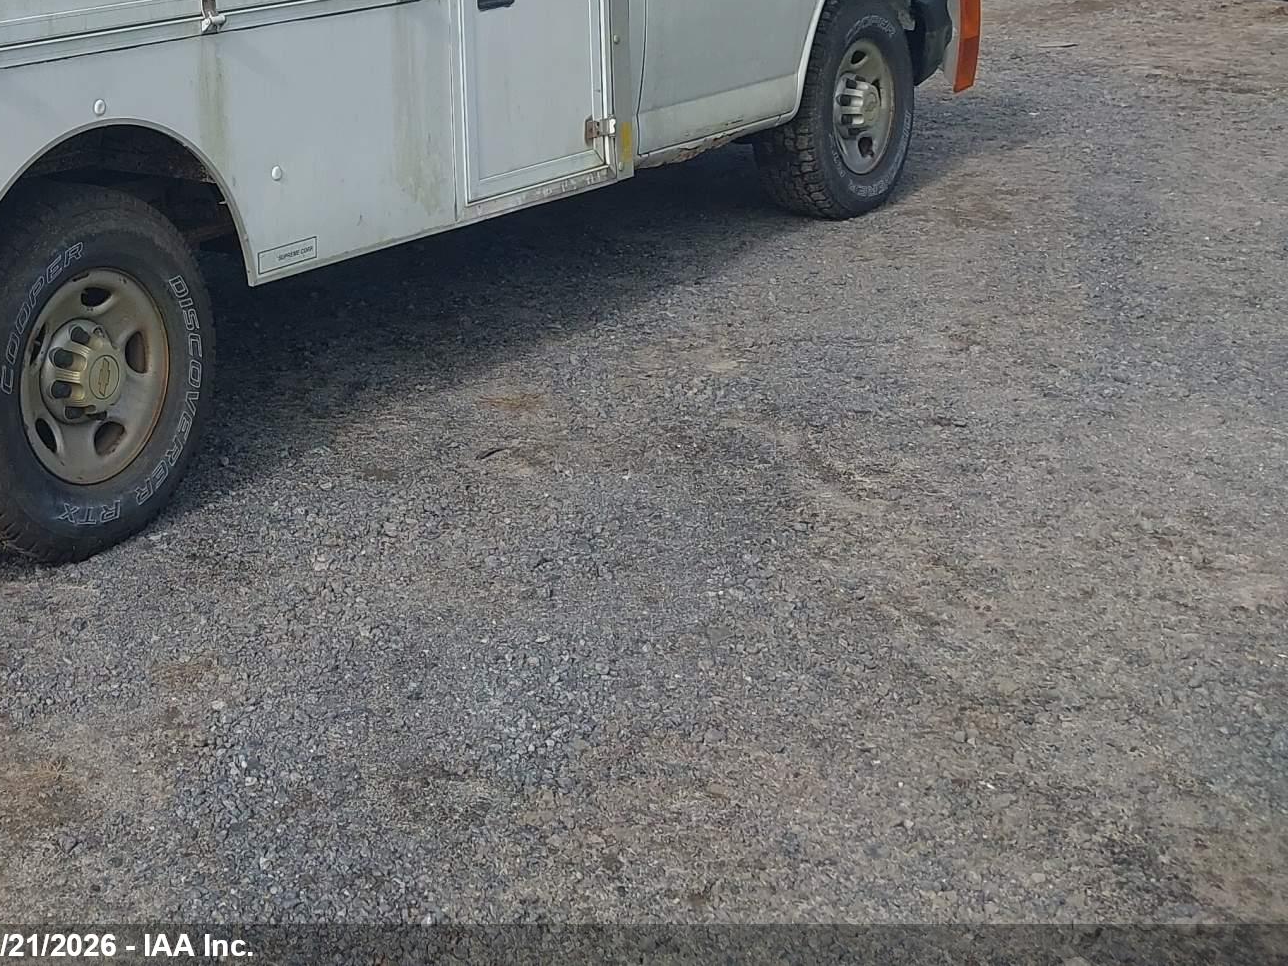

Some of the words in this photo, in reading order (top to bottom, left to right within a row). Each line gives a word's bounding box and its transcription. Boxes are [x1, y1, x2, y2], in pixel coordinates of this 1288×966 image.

[0, 241, 85, 395] COOPER
[134, 274, 204, 505] DISCOVERER
[58, 499, 122, 526] RTX
